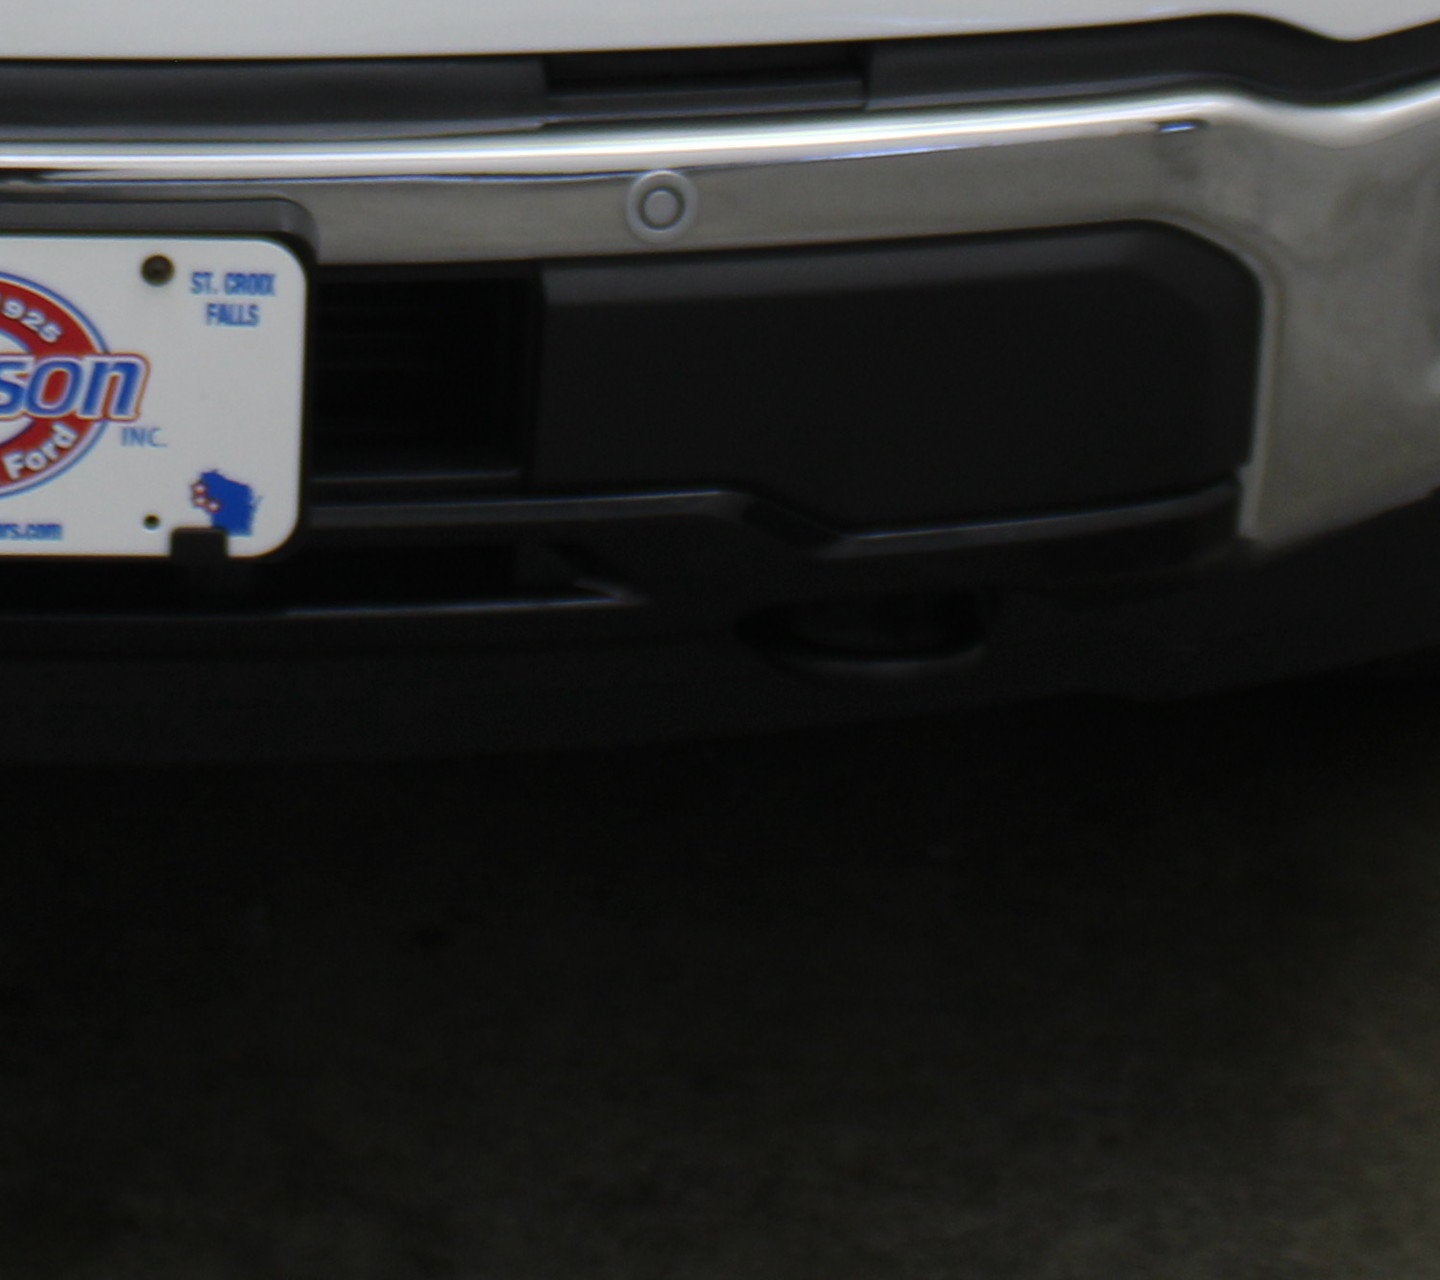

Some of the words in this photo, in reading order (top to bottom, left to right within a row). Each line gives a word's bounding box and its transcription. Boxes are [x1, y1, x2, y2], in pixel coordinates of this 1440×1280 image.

[190, 271, 219, 294] ST.
[206, 303, 260, 327] FALLS
[1, 420, 78, 480] Ford
